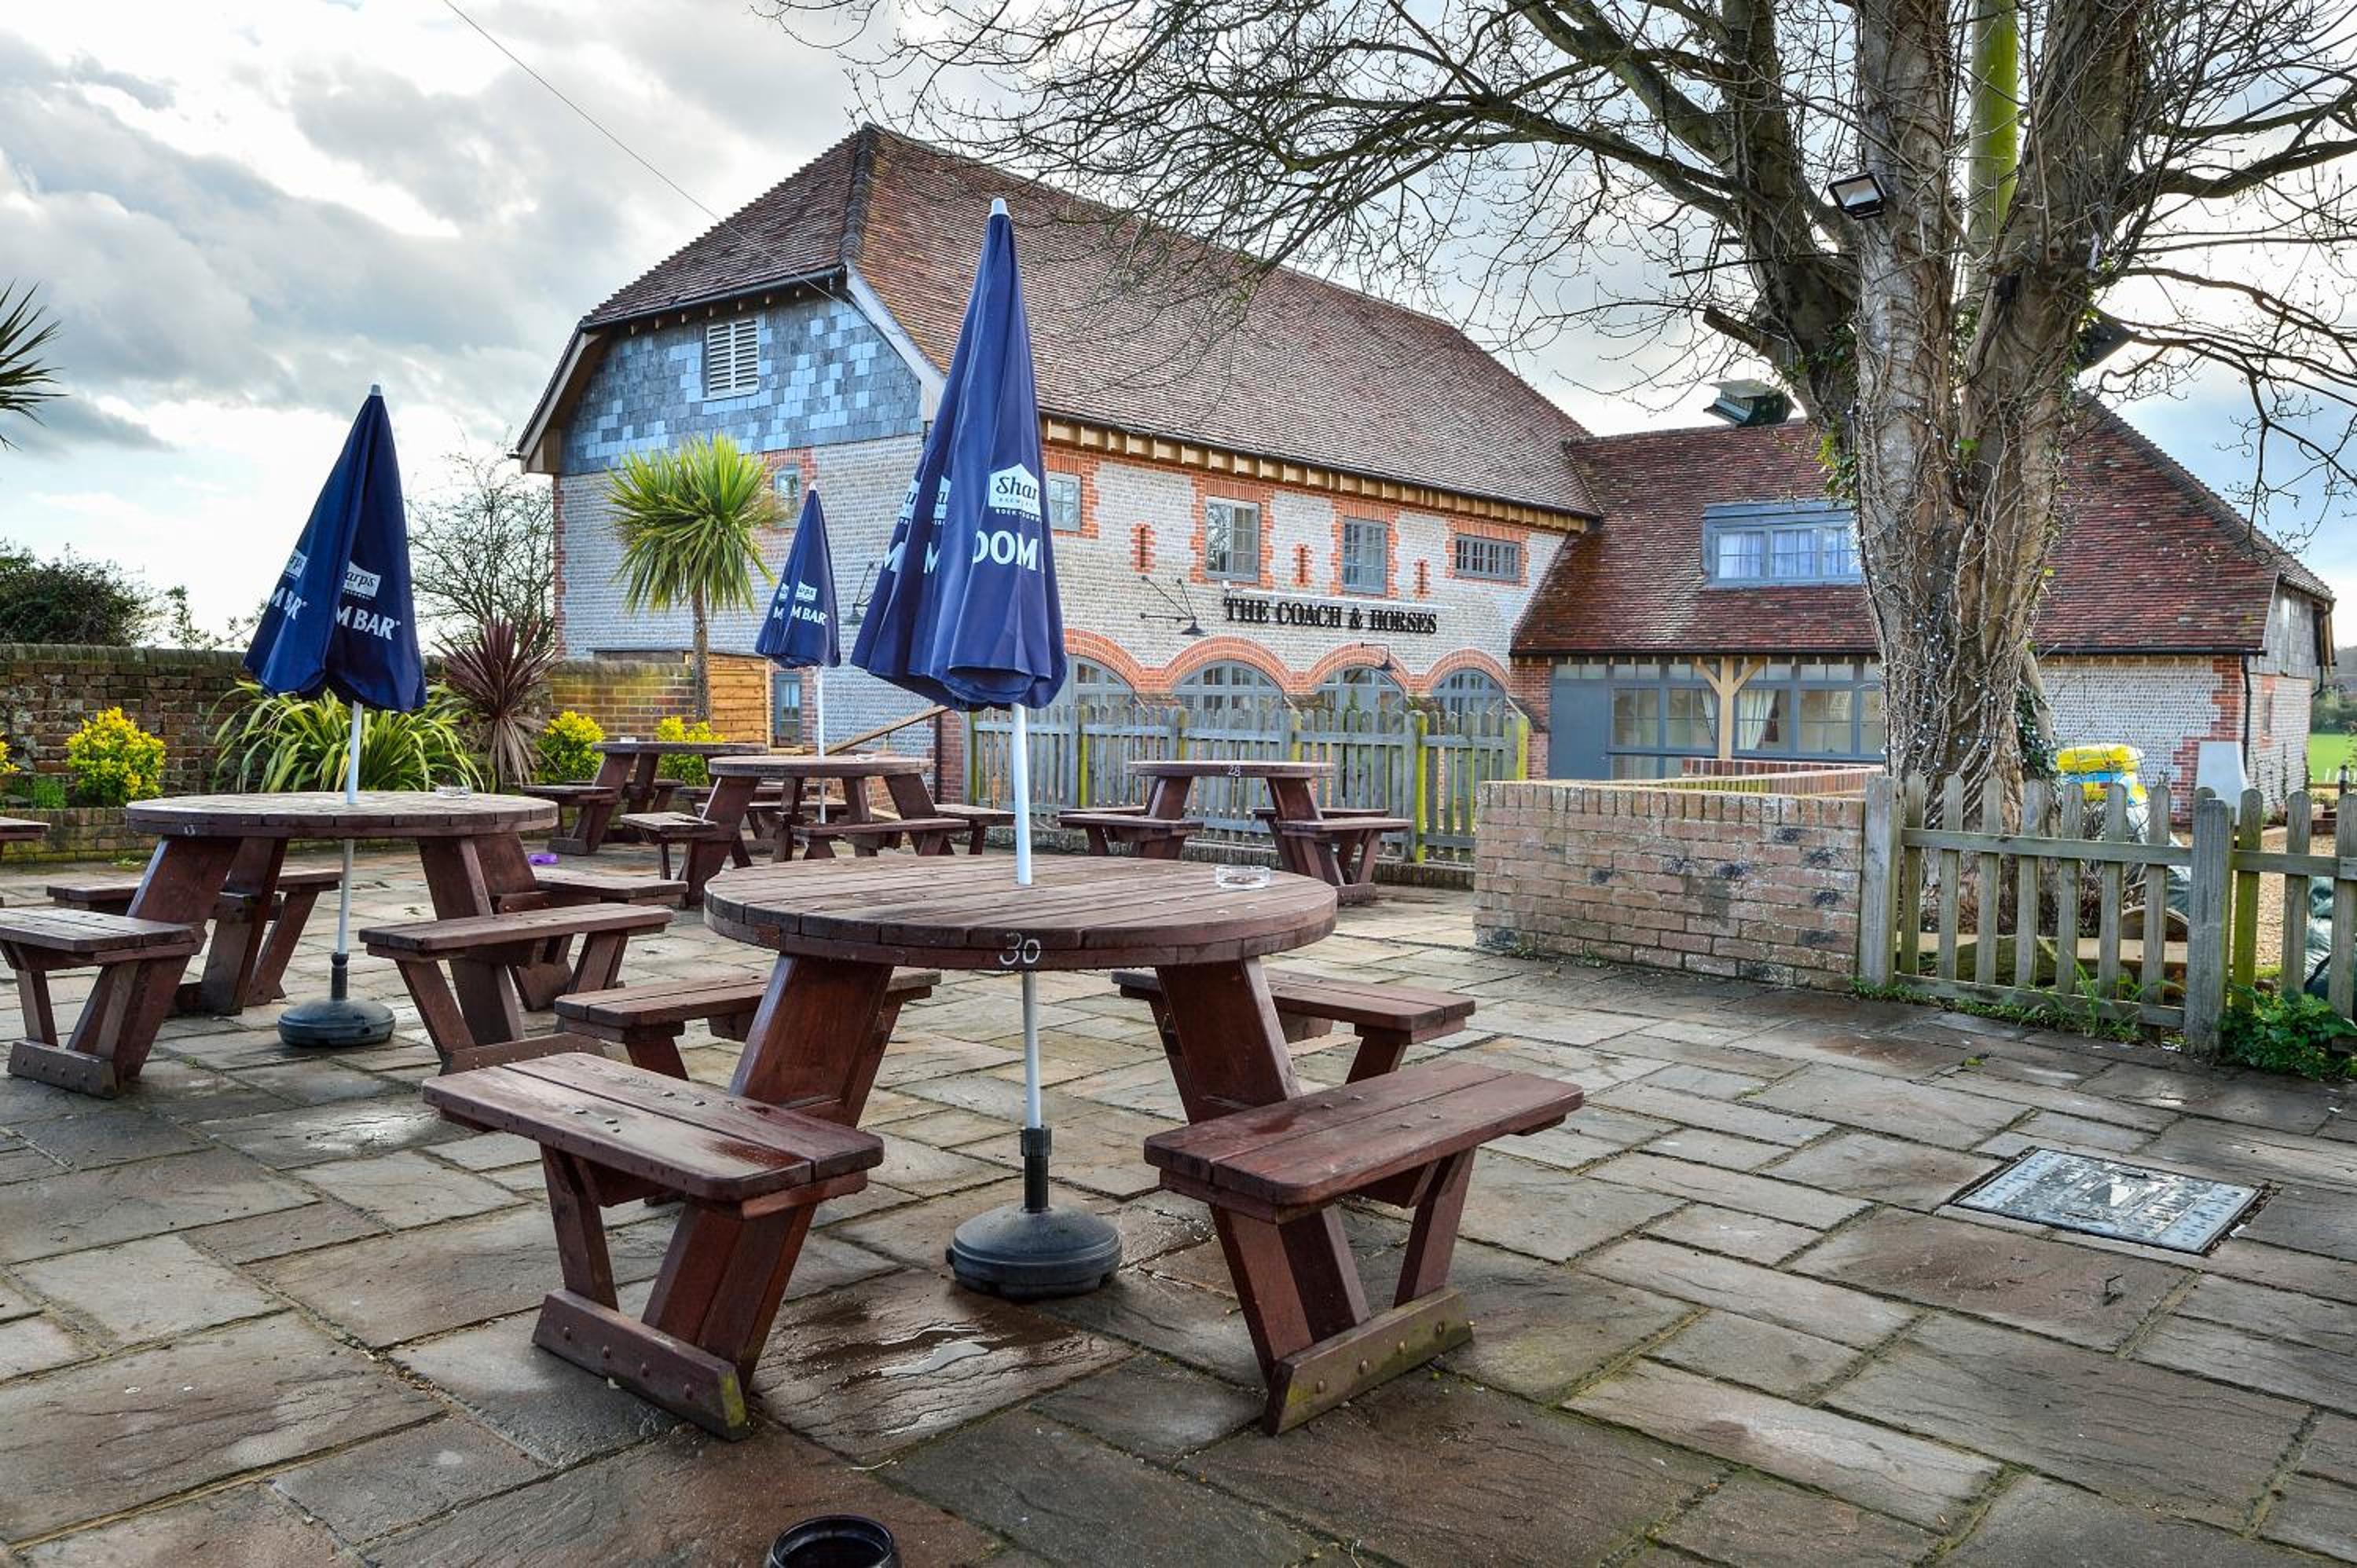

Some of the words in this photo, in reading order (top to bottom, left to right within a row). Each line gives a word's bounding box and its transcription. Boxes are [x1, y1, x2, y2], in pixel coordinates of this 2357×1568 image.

[996, 477, 1037, 500] Shar
[353, 608, 394, 640] BAR
[801, 607, 827, 626] BAR
[1222, 597, 1269, 623] THE
[1277, 602, 1342, 628] COACH
[1349, 607, 1363, 629] &
[1369, 609, 1438, 634] HORSES
[999, 930, 1042, 965] 30
